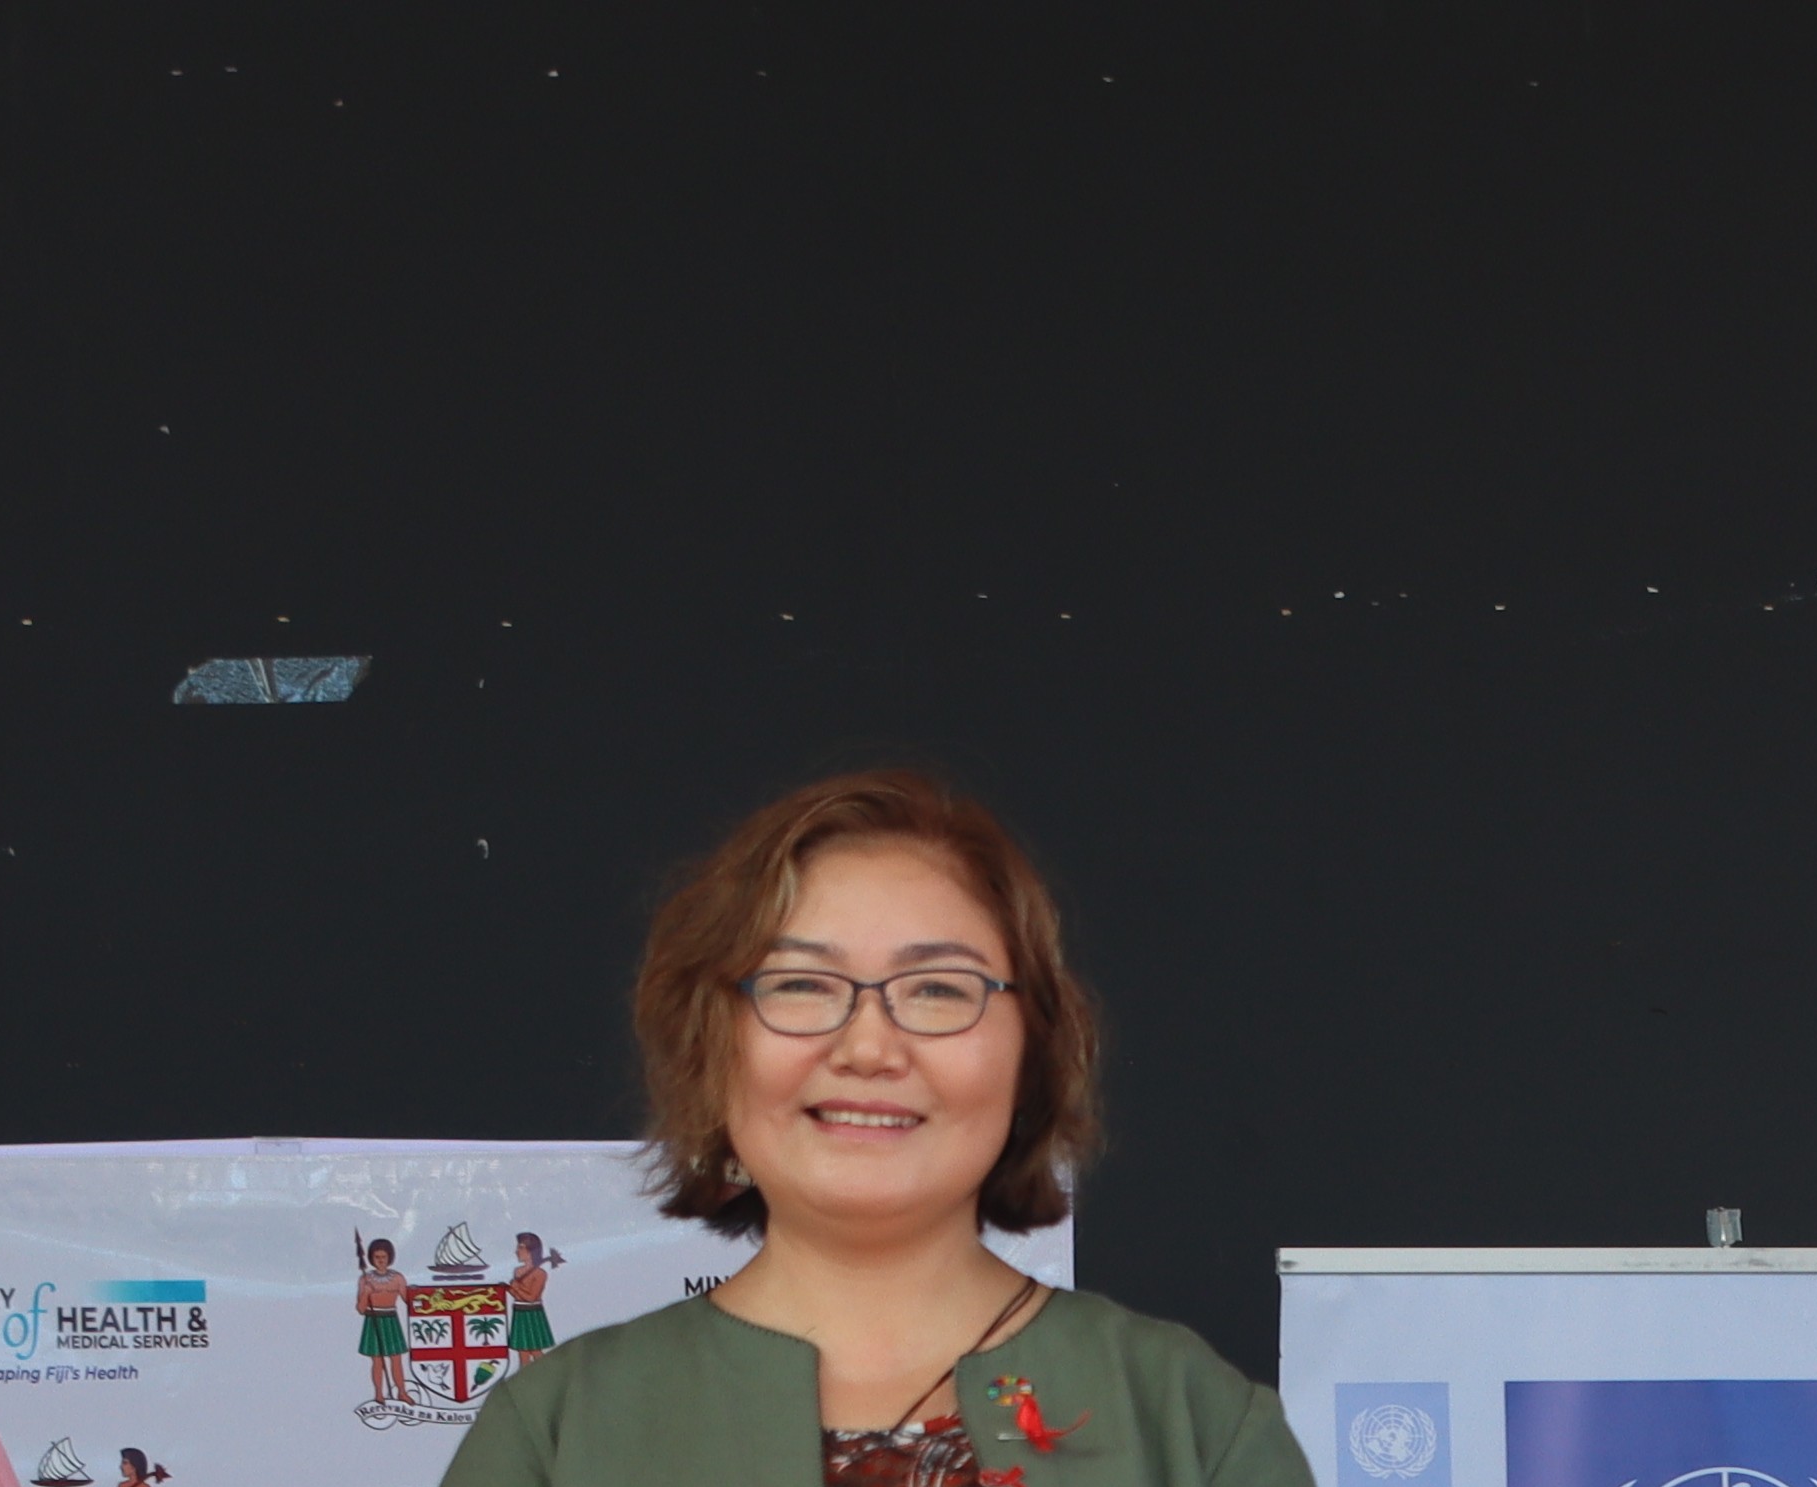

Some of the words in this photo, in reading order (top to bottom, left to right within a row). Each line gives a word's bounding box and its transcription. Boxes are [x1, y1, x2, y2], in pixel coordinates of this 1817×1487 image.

[3, 1282, 56, 1360] of
[57, 1307, 176, 1332] HEALTH
[187, 1306, 207, 1332] &
[57, 1336, 128, 1349] MEDICAL
[134, 1334, 209, 1348] SERVICES
[46, 1366, 80, 1382] Fiji's
[85, 1365, 138, 1380] Health
